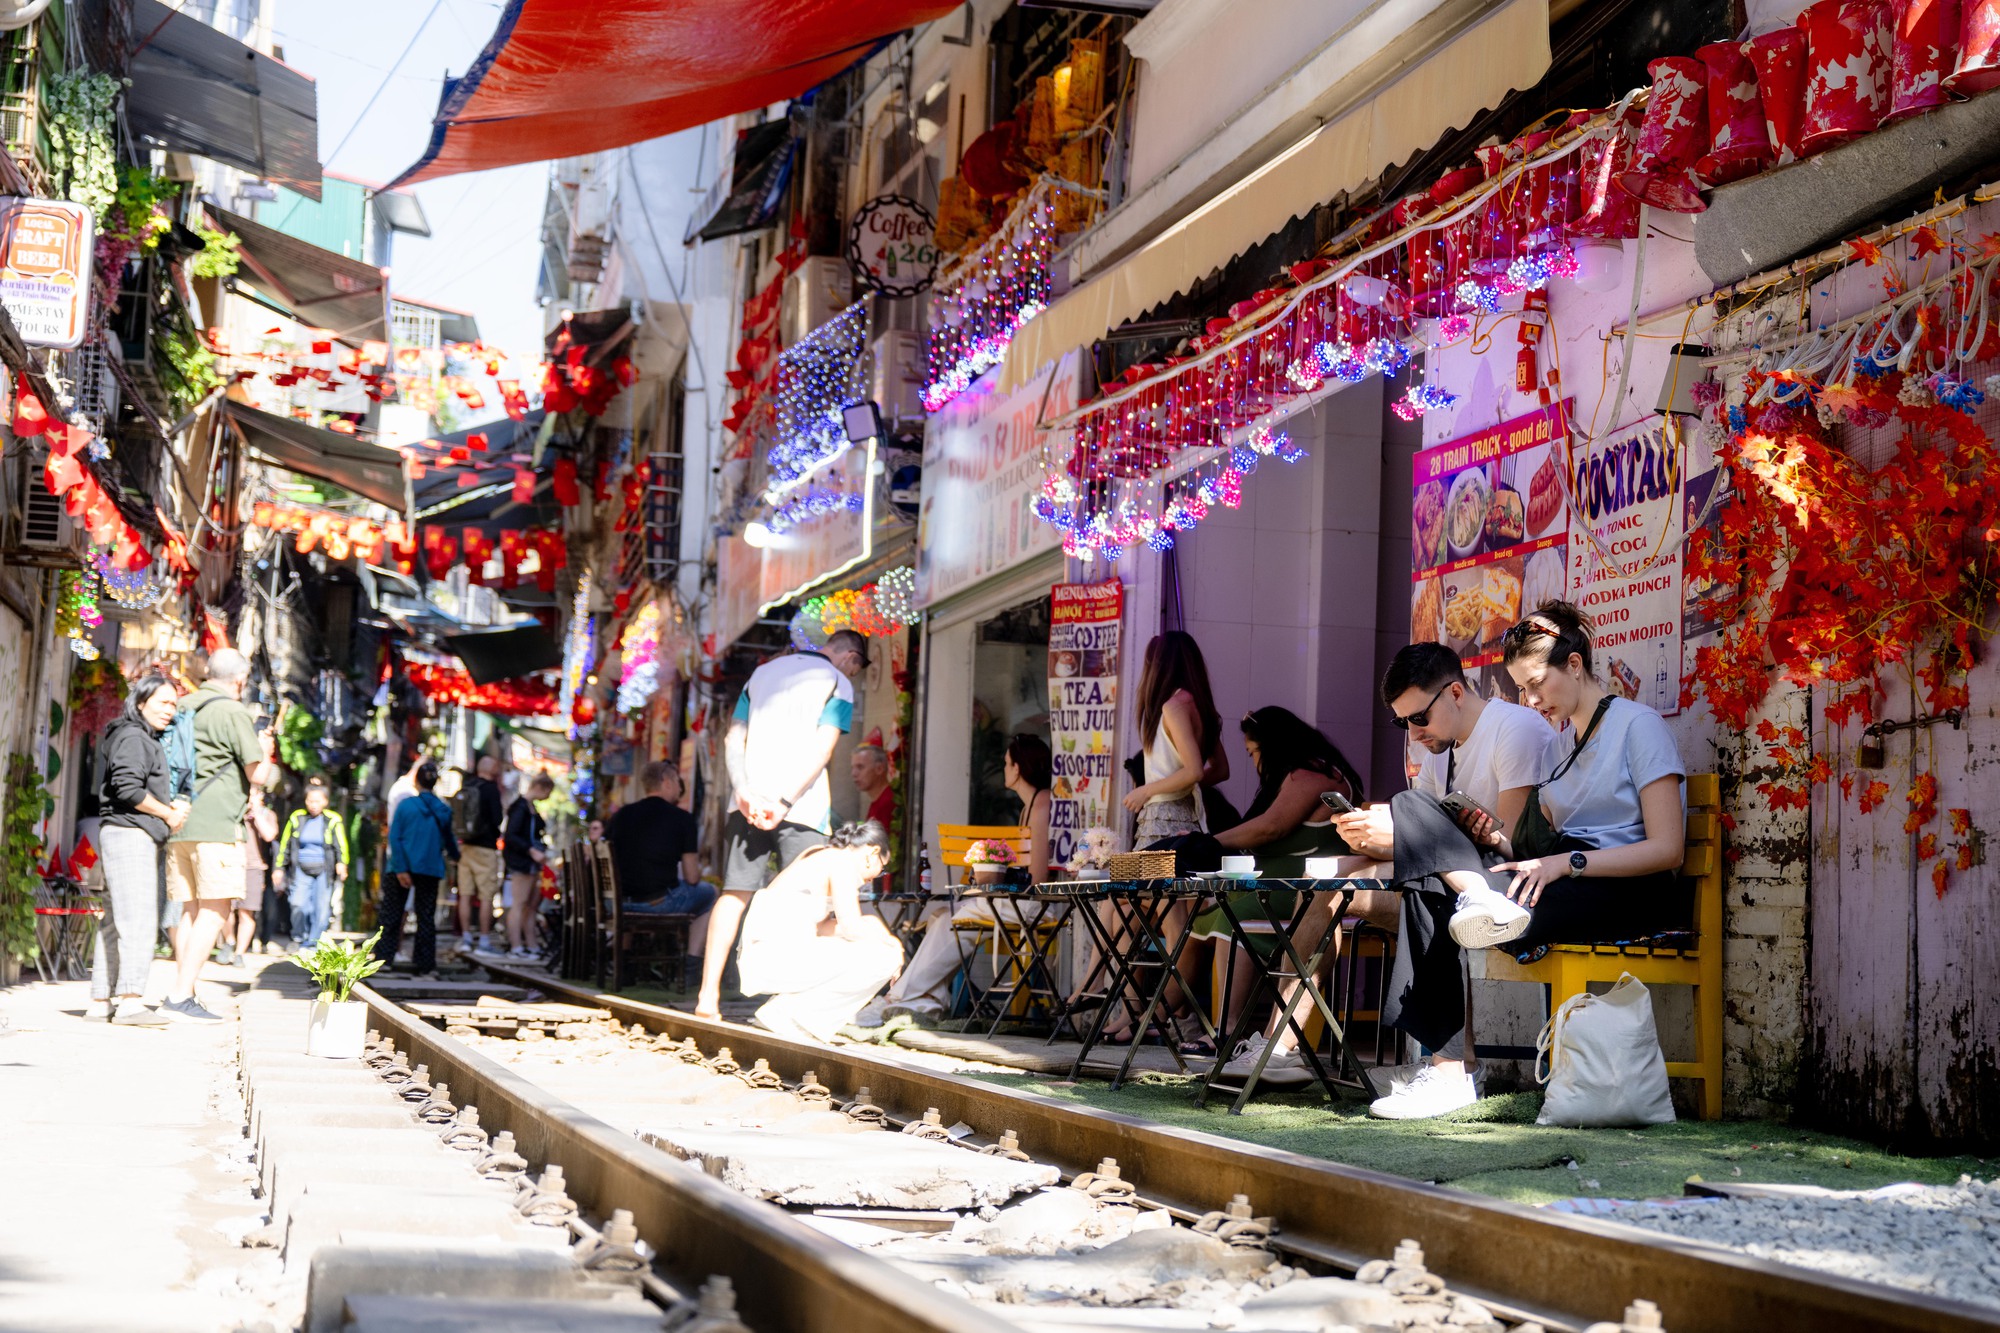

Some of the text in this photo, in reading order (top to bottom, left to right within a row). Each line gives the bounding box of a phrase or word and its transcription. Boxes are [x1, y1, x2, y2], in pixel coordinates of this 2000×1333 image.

[24, 217, 55, 230] LOCAL
[869, 212, 927, 241] Coffee
[13, 228, 66, 248] CRAFT
[16, 249, 61, 268] BEER
[4, 302, 67, 319] OMESTAY
[1430, 455, 1441, 477] 28
[1443, 443, 1469, 472] TRAIN
[1471, 434, 1501, 466] TRACK
[1509, 422, 1534, 453] good
[1536, 418, 1554, 440] day
[1575, 427, 1681, 520] COCKTAIL
[1587, 526, 1605, 543] IN
[1607, 514, 1643, 535] TONIC
[1494, 550, 1506, 560] Bread
[1611, 536, 1647, 556] COCA
[1467, 559, 1476, 567] soup
[1586, 560, 1640, 584] WHISKEY
[1055, 586, 1083, 601] MENU
[1582, 575, 1671, 607] VODKA PUNCH
[1075, 624, 1117, 649] COFFEE
[1590, 621, 1673, 650] VIRGIN MOJITO
[1064, 681, 1103, 705] TEA
[1050, 710, 1079, 732] FRUIT
[1049, 800, 1080, 829] EER
